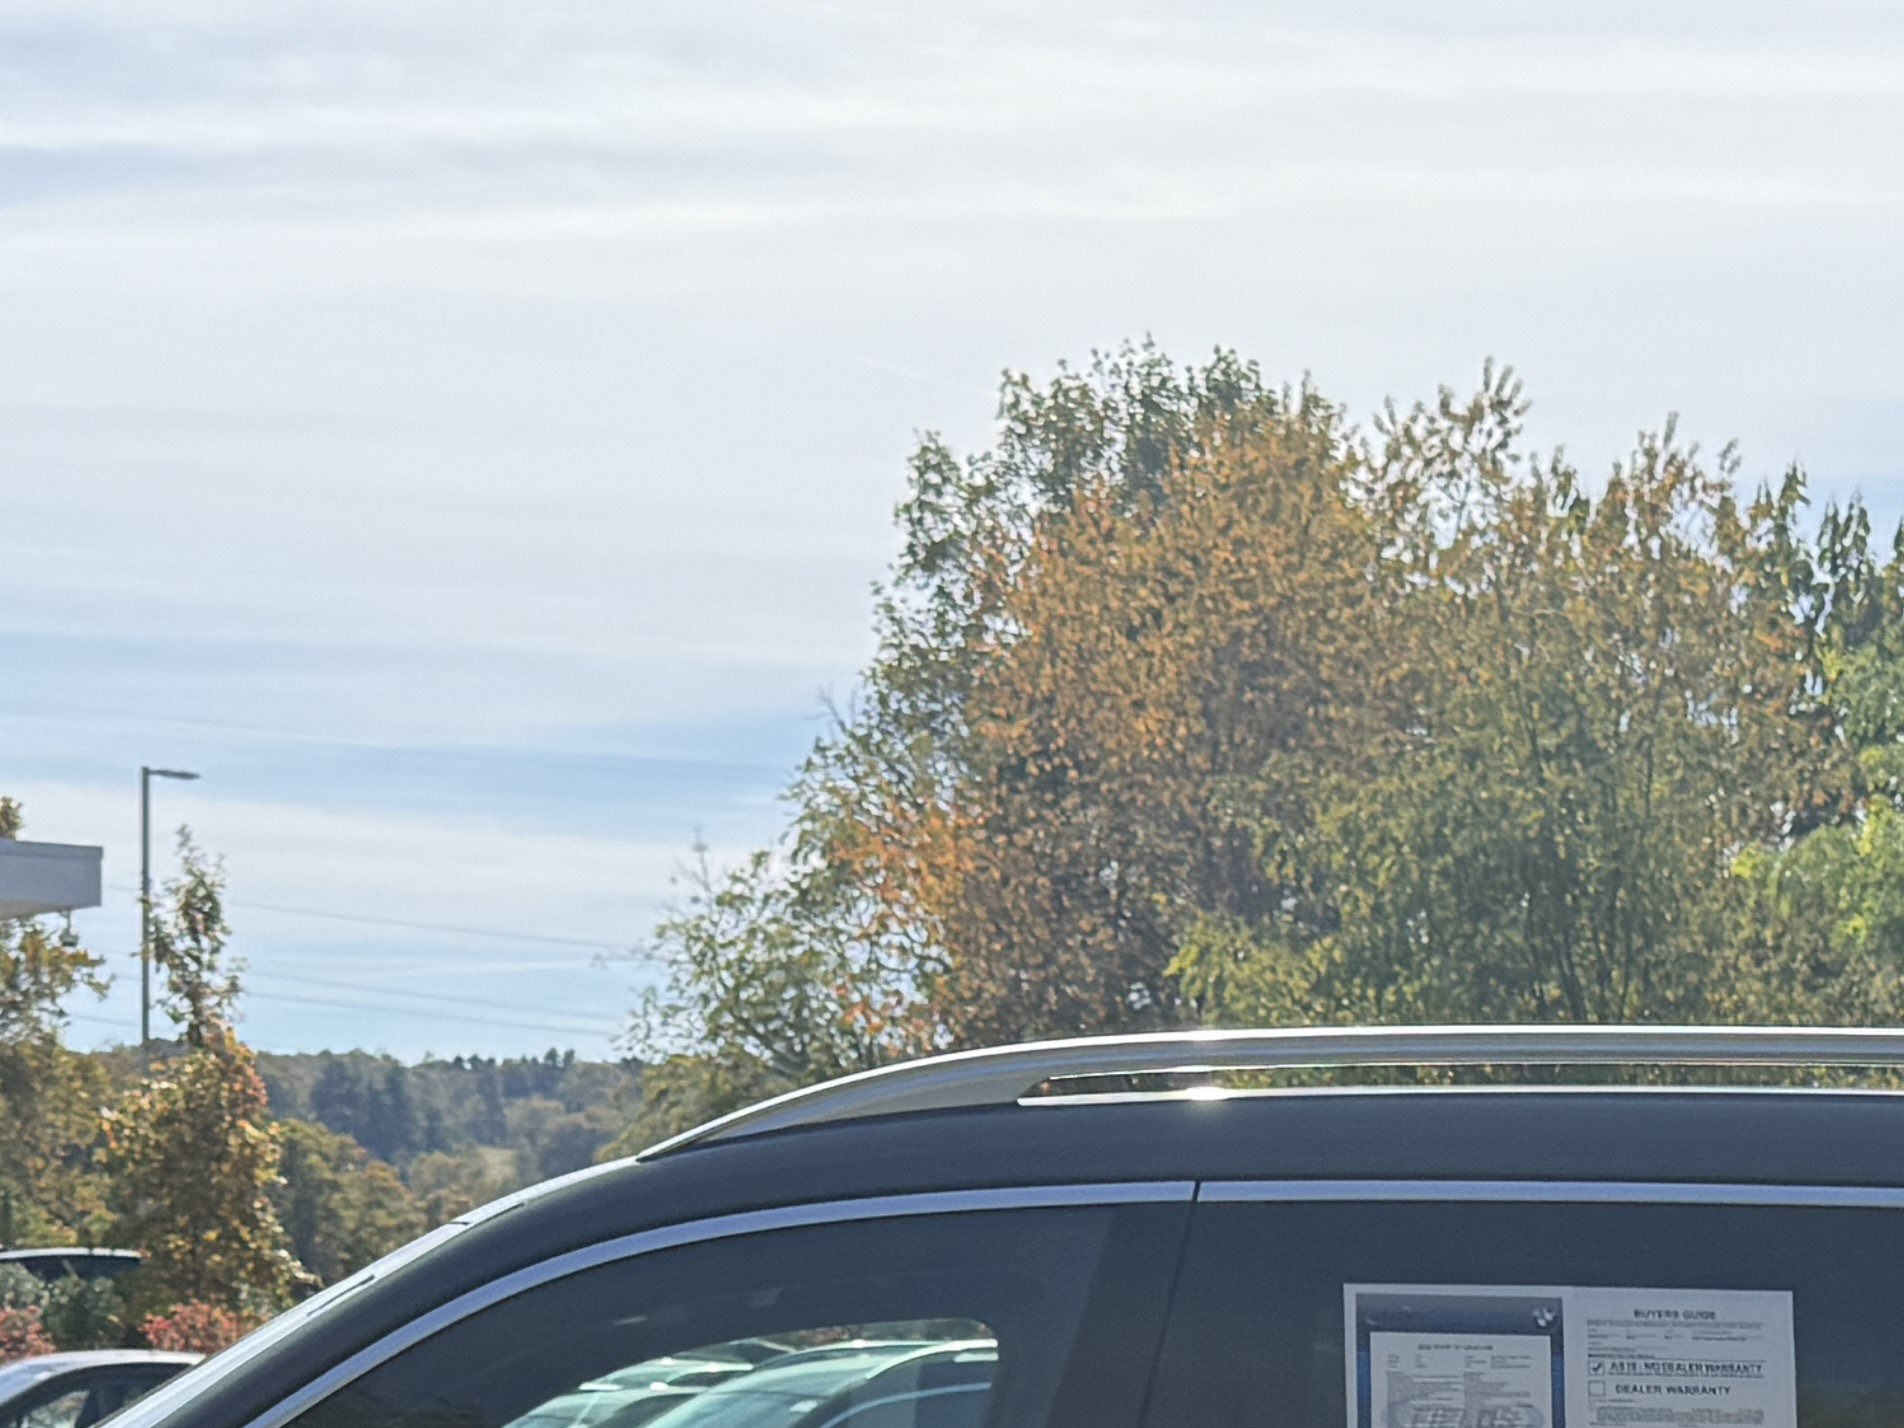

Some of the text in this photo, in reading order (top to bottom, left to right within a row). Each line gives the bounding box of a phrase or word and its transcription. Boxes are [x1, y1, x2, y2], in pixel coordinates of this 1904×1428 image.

[1634, 1309, 1680, 1320] BUYERS
[1615, 1384, 1731, 1396] DEALER WARRANTY
